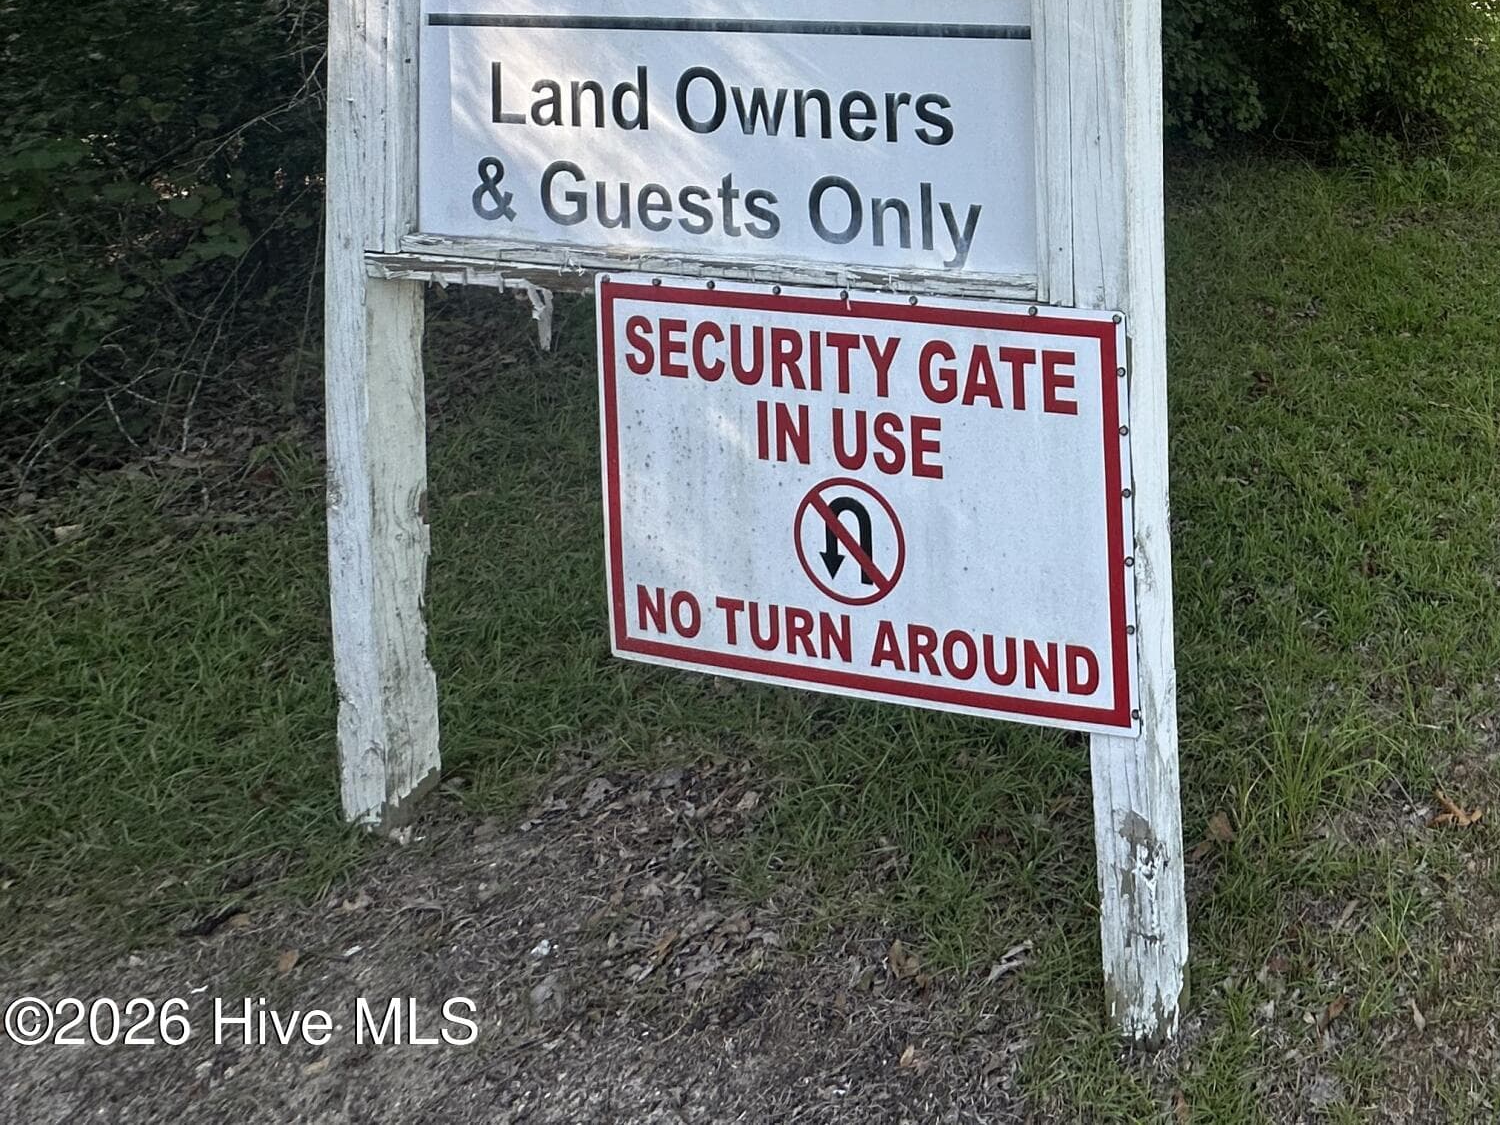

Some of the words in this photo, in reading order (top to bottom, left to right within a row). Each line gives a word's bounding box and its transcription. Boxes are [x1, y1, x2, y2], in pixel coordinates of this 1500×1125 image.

[491, 61, 649, 131] Land
[675, 65, 954, 146] Owners
[472, 156, 517, 222] &
[540, 160, 781, 240] Guests
[808, 175, 983, 268] Only
[624, 315, 901, 398] SECURITY
[919, 340, 1078, 416] GATE
[756, 400, 811, 465] IN
[832, 408, 944, 480] USE
[636, 584, 701, 638] NO
[716, 597, 852, 663] TURN
[871, 620, 1100, 696] AROUND
